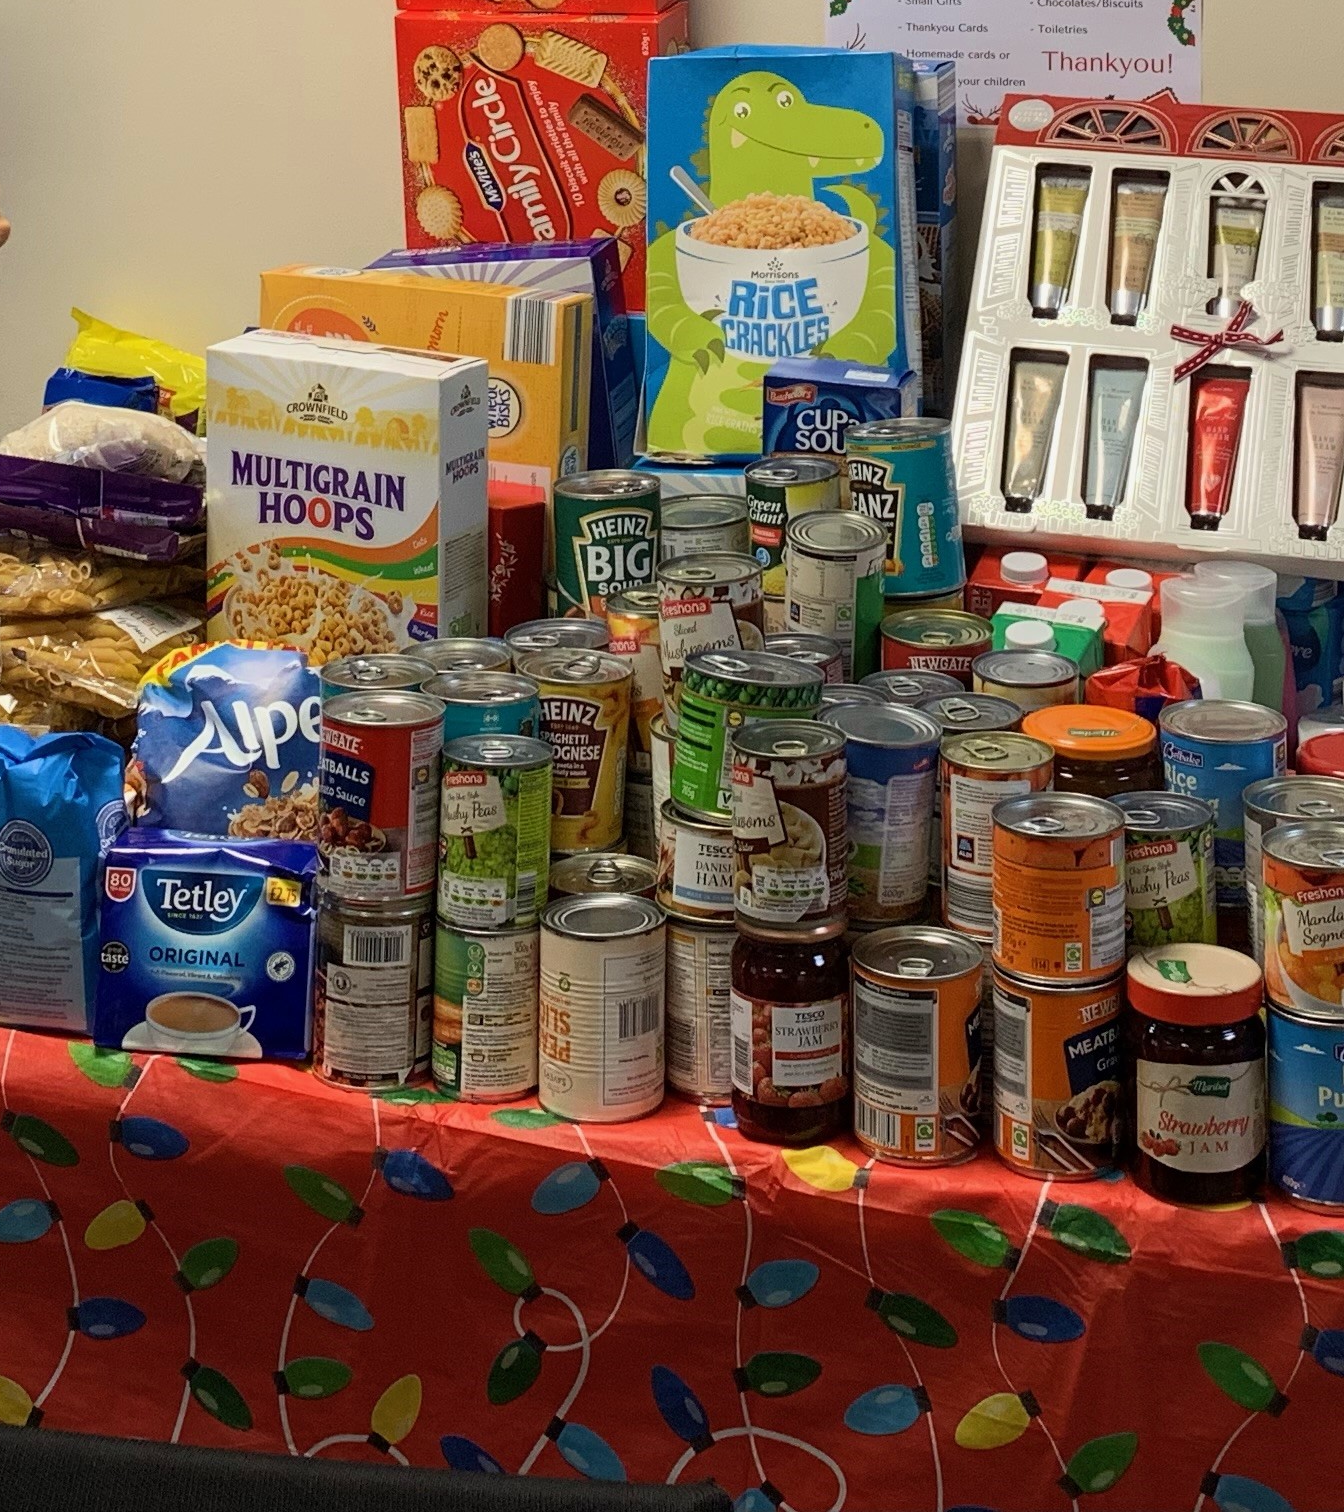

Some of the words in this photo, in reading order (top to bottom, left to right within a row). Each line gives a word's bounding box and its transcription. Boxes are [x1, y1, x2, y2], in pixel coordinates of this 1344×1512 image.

[906, 23, 954, 34] Thankyou
[958, 23, 988, 33] Cards
[1038, 24, 1088, 34] Toiletries
[907, 50, 964, 59] Homemade
[968, 50, 996, 59] cards
[1000, 51, 1010, 59] or
[1042, 52, 1172, 79] Thankyou!
[958, 78, 980, 88] your
[984, 77, 1025, 86] children
[472, 77, 521, 163] Circle
[751, 271, 799, 279] Morrisons
[721, 316, 829, 357] CRACKLES
[286, 403, 348, 422] CROWNFIELD
[496, 389, 511, 428] Bisks
[231, 450, 405, 512] MULTIGRAIN
[747, 495, 782, 513] Green
[259, 492, 374, 541] HOOPS
[749, 508, 784, 525] Giant
[591, 517, 647, 540] HEINZ
[586, 541, 651, 582] BIG
[909, 656, 972, 671] NEWGATE
[161, 696, 321, 783] Alpe
[110, 873, 131, 887] 80
[696, 872, 733, 887] HAM
[1165, 870, 1189, 888] Peas
[157, 879, 247, 922] Tetley
[269, 887, 297, 903] £2.75
[101, 952, 129, 965] taste
[149, 947, 245, 968] ORIGINAL
[795, 1010, 825, 1022] TESCO
[775, 1021, 839, 1037] STRAWBERRY
[798, 1035, 823, 1048] JAM
[1159, 1110, 1249, 1137] Strawberry
[1190, 1140, 1229, 1155] JAM
